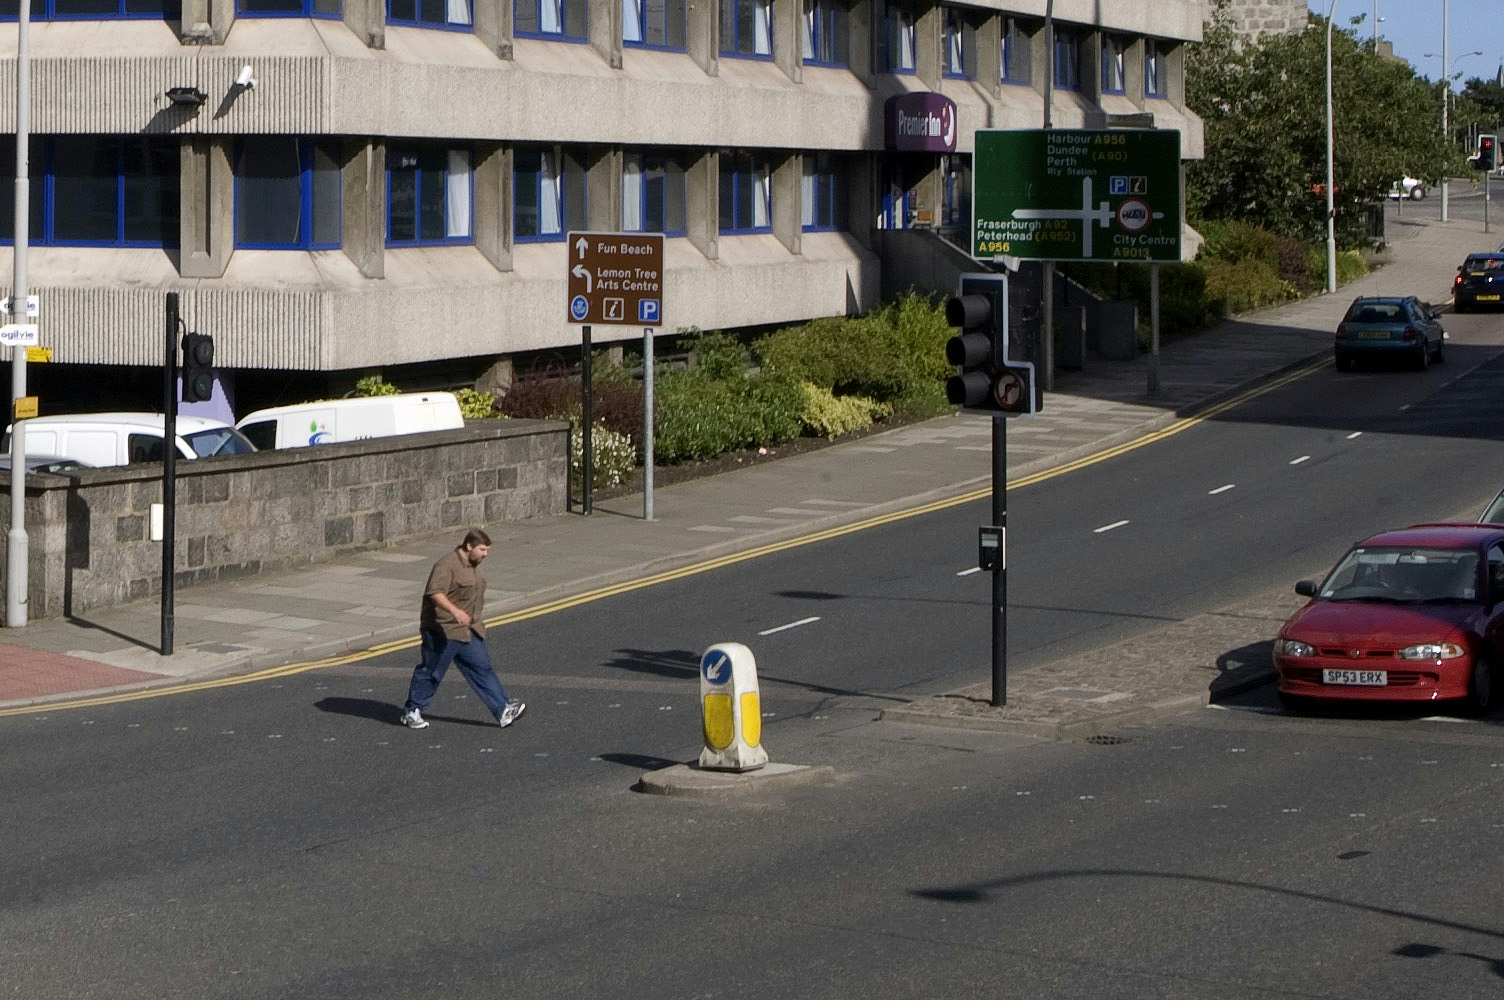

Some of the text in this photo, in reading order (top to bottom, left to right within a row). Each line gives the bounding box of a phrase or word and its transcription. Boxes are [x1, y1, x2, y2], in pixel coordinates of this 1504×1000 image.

[898, 109, 941, 136] Premier Inn
[1047, 133, 1126, 145] Harbour A956
[1047, 145, 1088, 155] Dundee
[1047, 156, 1077, 167] Perth
[1092, 151, 1128, 162] (A90)
[1067, 167, 1098, 176] Station
[977, 219, 1042, 231] Fraserburgh
[977, 230, 1033, 241] Peterhead
[1113, 234, 1176, 246] City Centre
[597, 242, 653, 255] Fun Beach
[597, 267, 657, 280] Lemon Tree
[596, 280, 659, 292] Arts Centre
[643, 301, 657, 319] P
[0, 330, 34, 340] ogilvie
[1327, 670, 1382, 684] SP53 ERX
